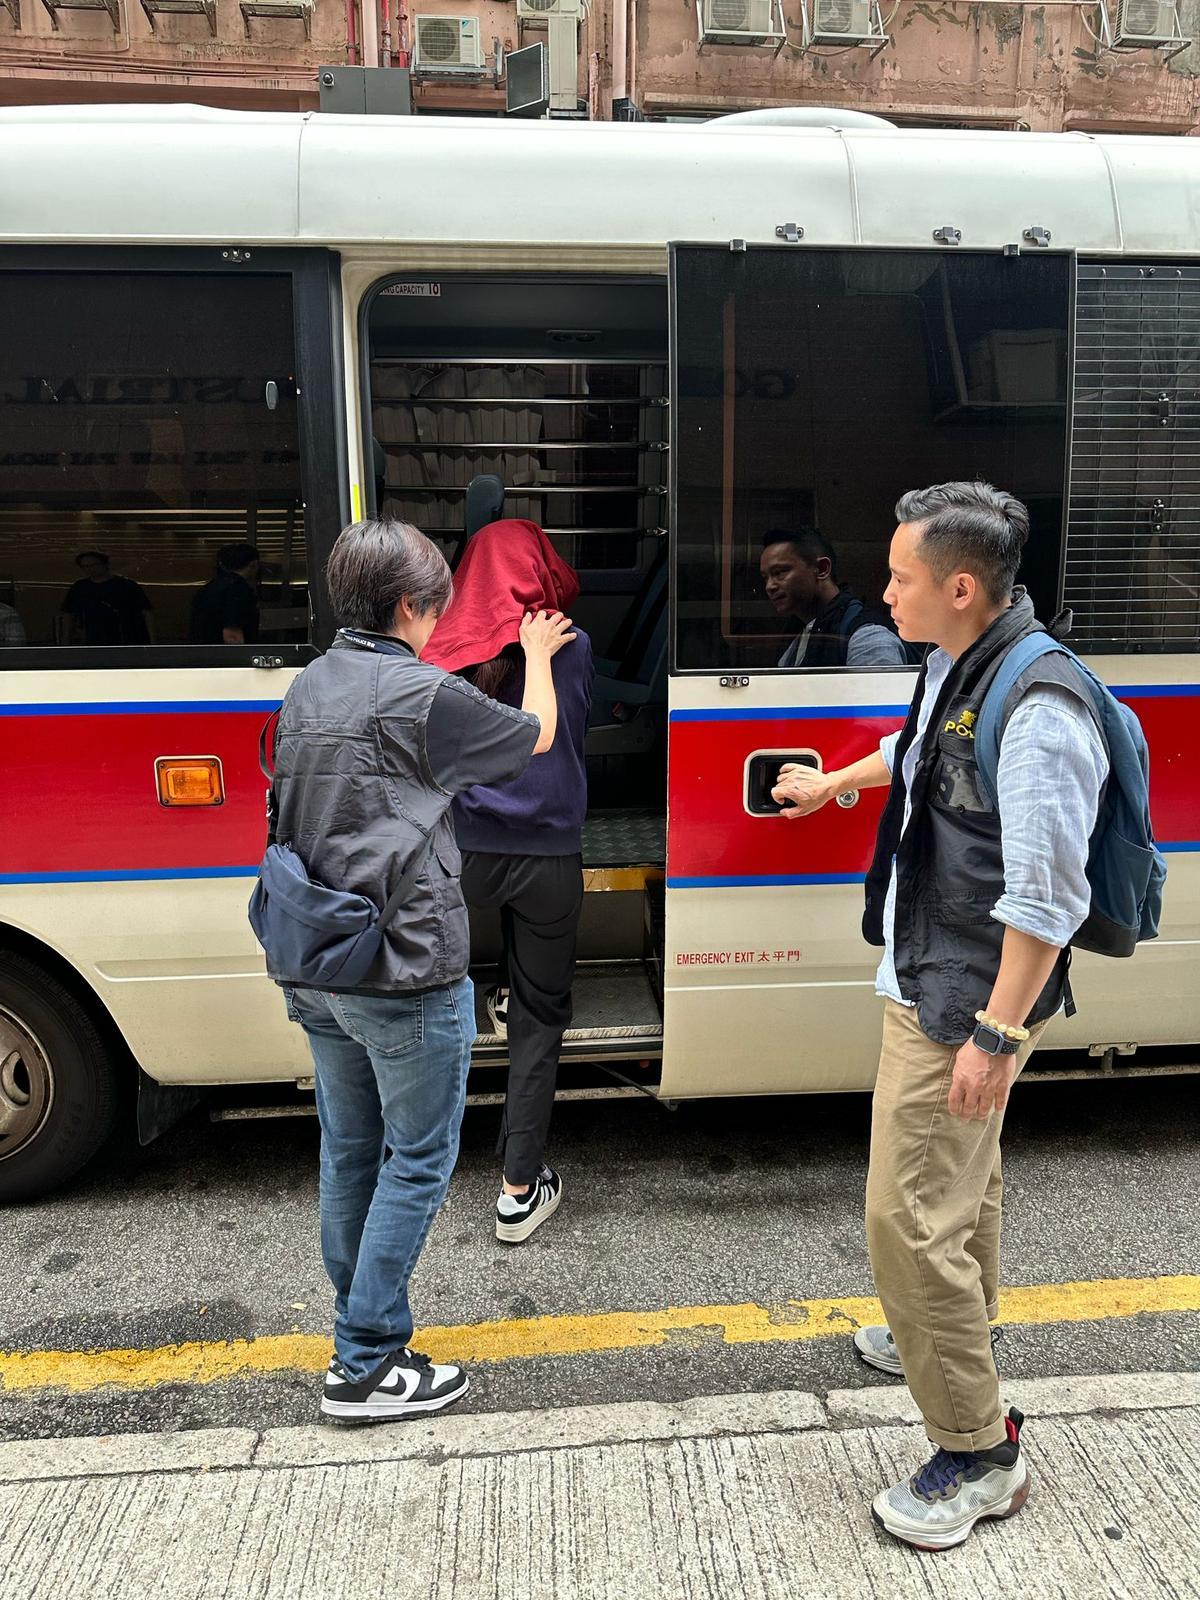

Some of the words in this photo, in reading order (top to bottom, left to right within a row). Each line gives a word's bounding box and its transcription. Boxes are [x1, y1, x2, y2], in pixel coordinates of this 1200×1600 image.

[395, 284, 425, 295] CAPACITY
[428, 282, 440, 296] 10
[944, 720, 975, 739] POL
[676, 952, 732, 966] EMERGENCY
[734, 951, 755, 964] EXIT
[757, 949, 801, 963] 太平門
